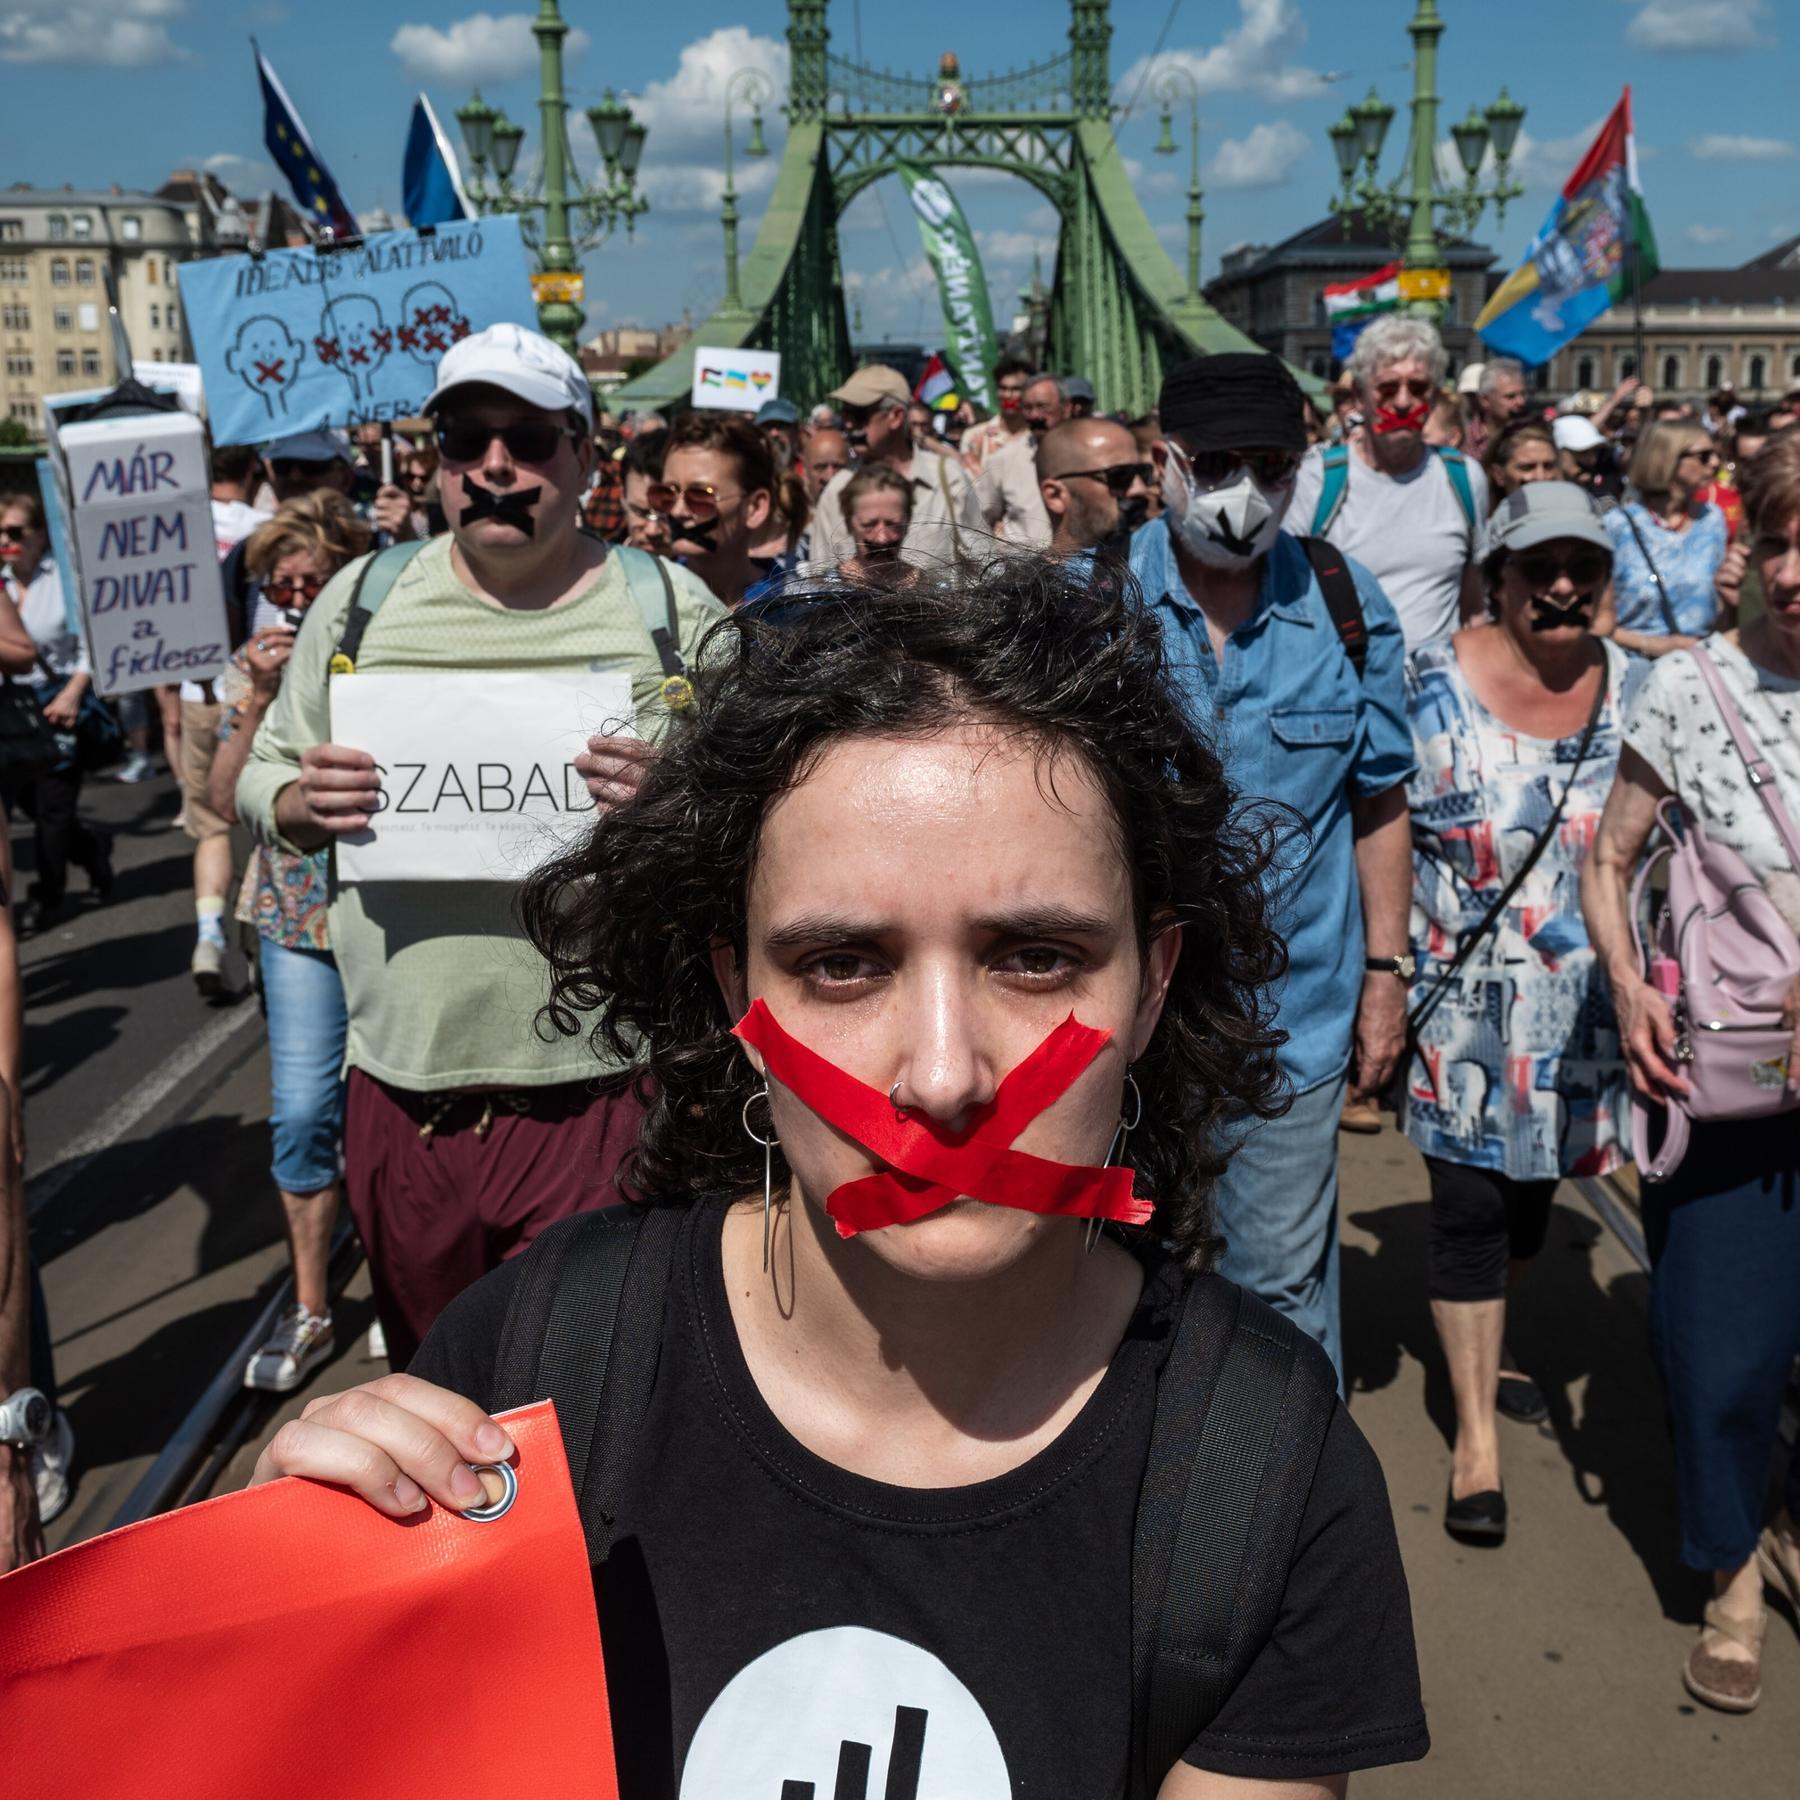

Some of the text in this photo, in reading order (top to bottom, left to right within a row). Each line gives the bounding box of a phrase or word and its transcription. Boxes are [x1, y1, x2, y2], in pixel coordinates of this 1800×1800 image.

[83, 443, 180, 501] MÁR
[98, 511, 187, 561] NEM
[91, 563, 198, 615] DIVAT
[132, 618, 160, 640] a
[104, 638, 225, 690] fidesz
[357, 762, 599, 813] SZABAD
